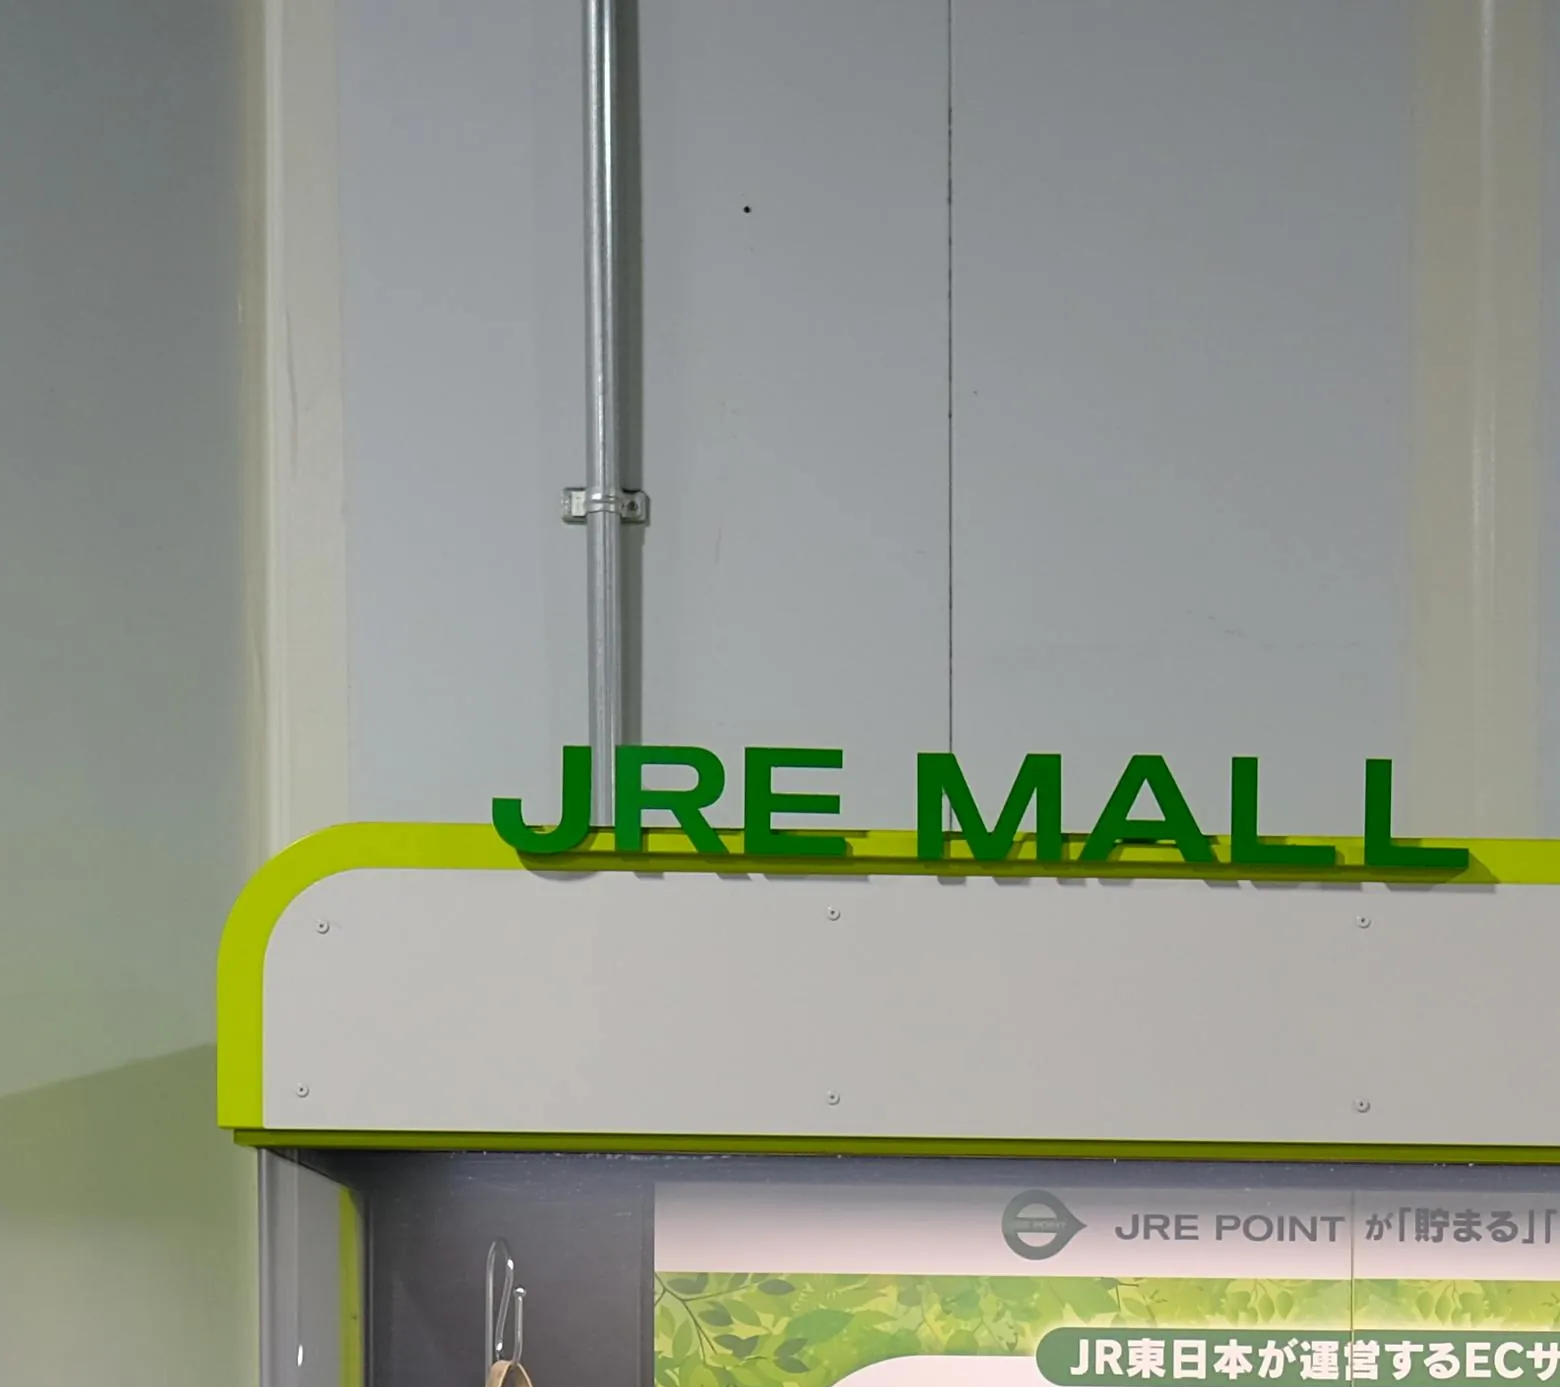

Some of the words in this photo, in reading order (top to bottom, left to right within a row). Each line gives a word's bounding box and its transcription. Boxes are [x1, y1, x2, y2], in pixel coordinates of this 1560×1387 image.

[492, 745, 843, 855] JRE
[917, 752, 1469, 869] MALL
[1115, 1214, 1199, 1240] JRE
[1215, 1215, 1345, 1242] POINT
